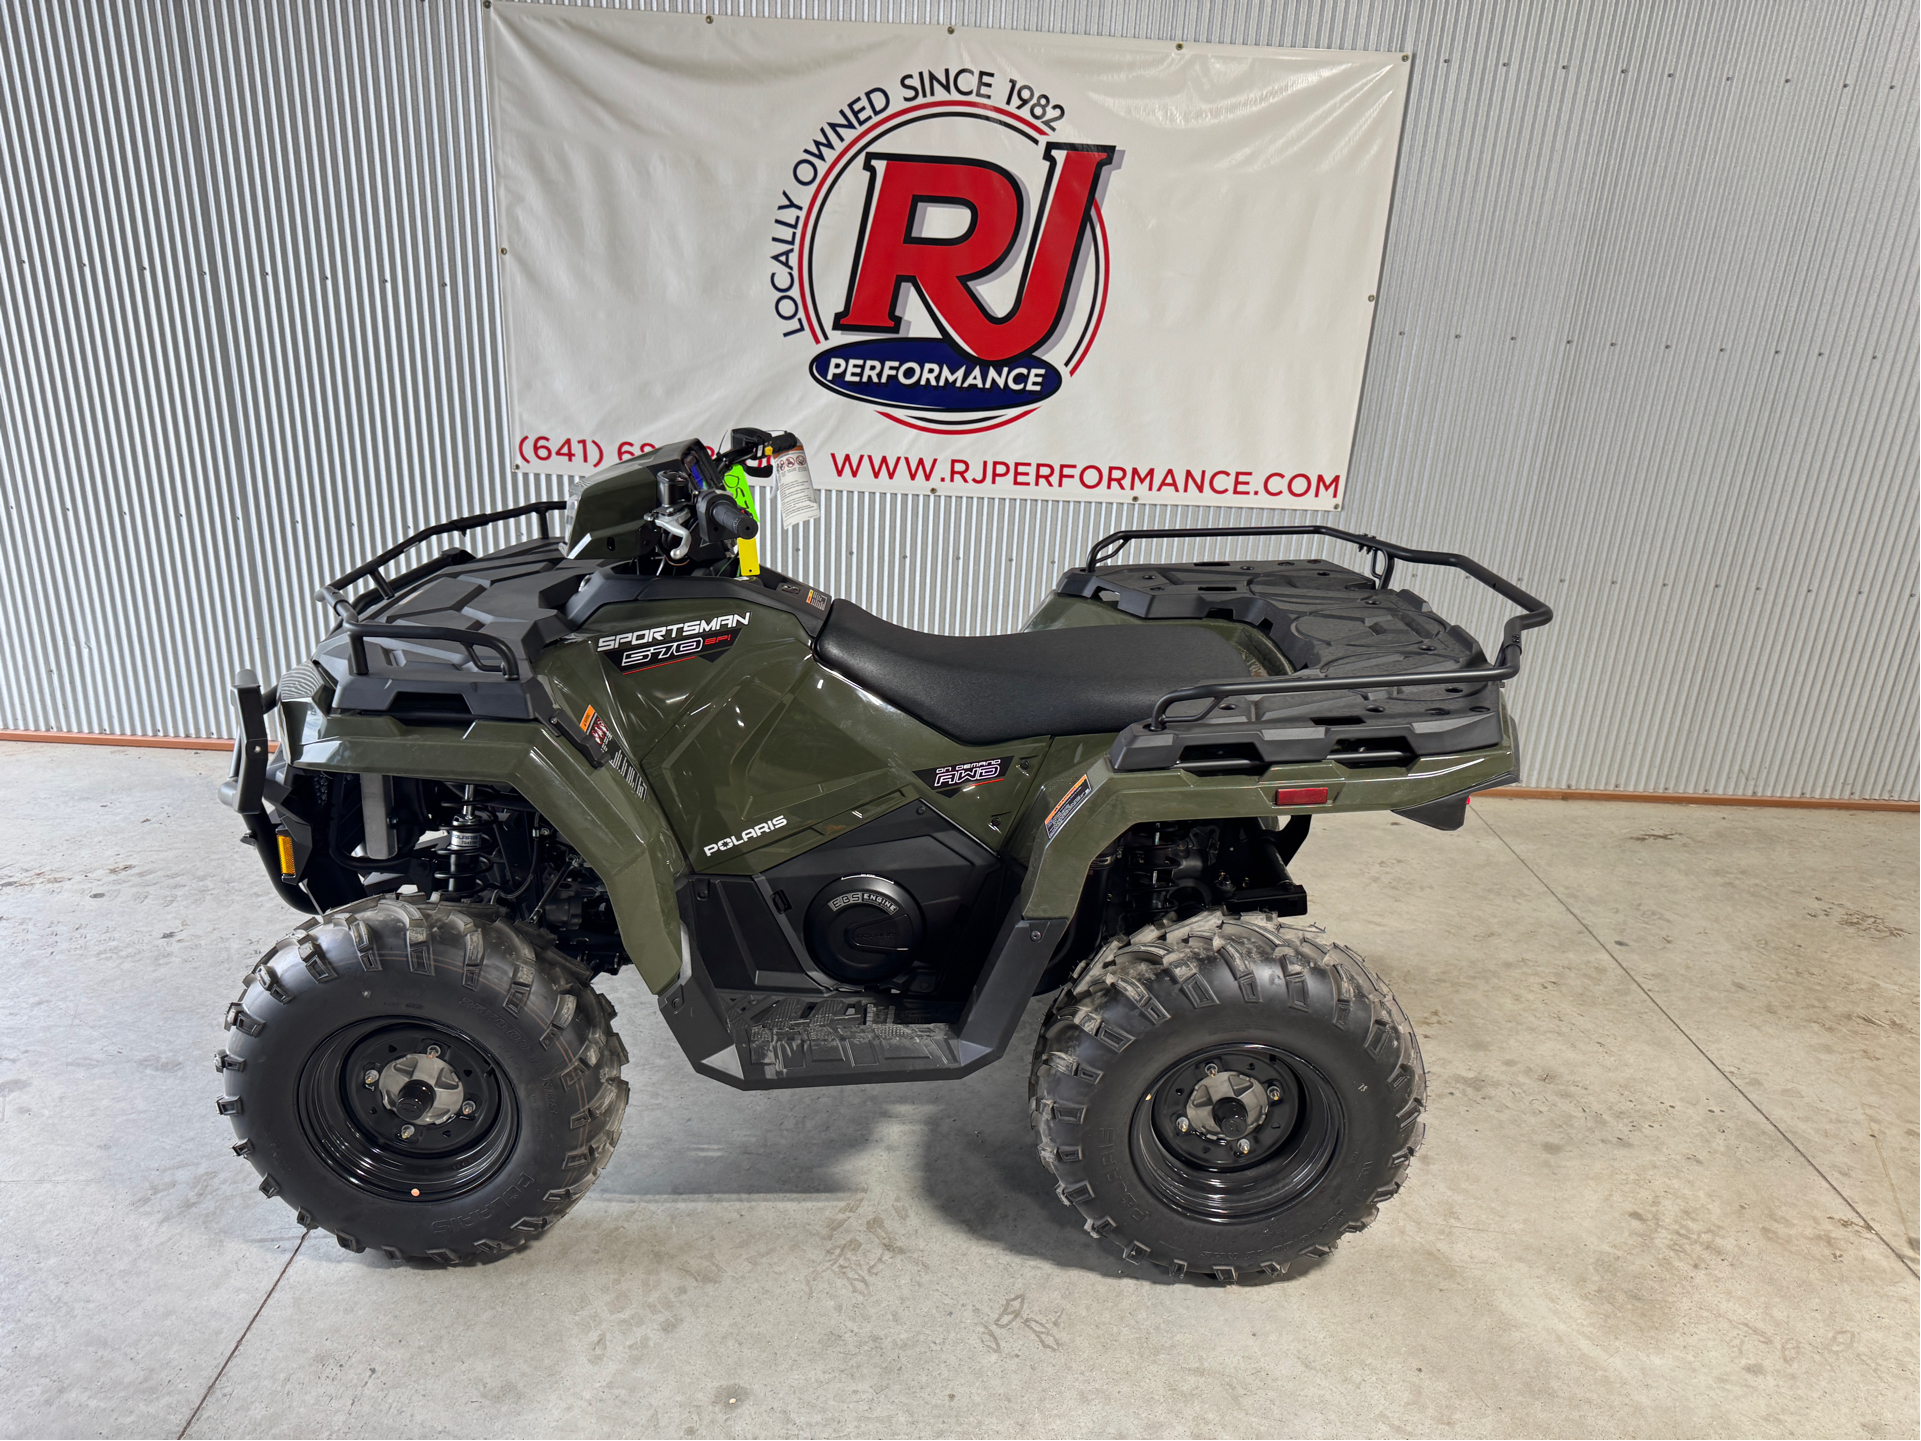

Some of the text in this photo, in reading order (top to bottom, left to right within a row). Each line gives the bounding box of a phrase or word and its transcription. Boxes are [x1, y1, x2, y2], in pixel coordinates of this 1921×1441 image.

[770, 68, 1066, 338] LOCALLY OWNED SINCE 1982
[832, 141, 1121, 366] RJ
[826, 356, 1046, 392] PERFORMANCE
[518, 435, 604, 468] (641)
[830, 452, 1341, 499] WWW.RJPERFORMANCE.COM
[597, 611, 751, 652] SPORTSMAN
[621, 637, 704, 667] 570
[934, 765, 1000, 787] AWD
[936, 759, 1001, 774] ON DEMAND
[703, 814, 788, 857] POLARIS
[863, 893, 897, 912] ENGINE
[431, 1171, 536, 1234] POLARIS
